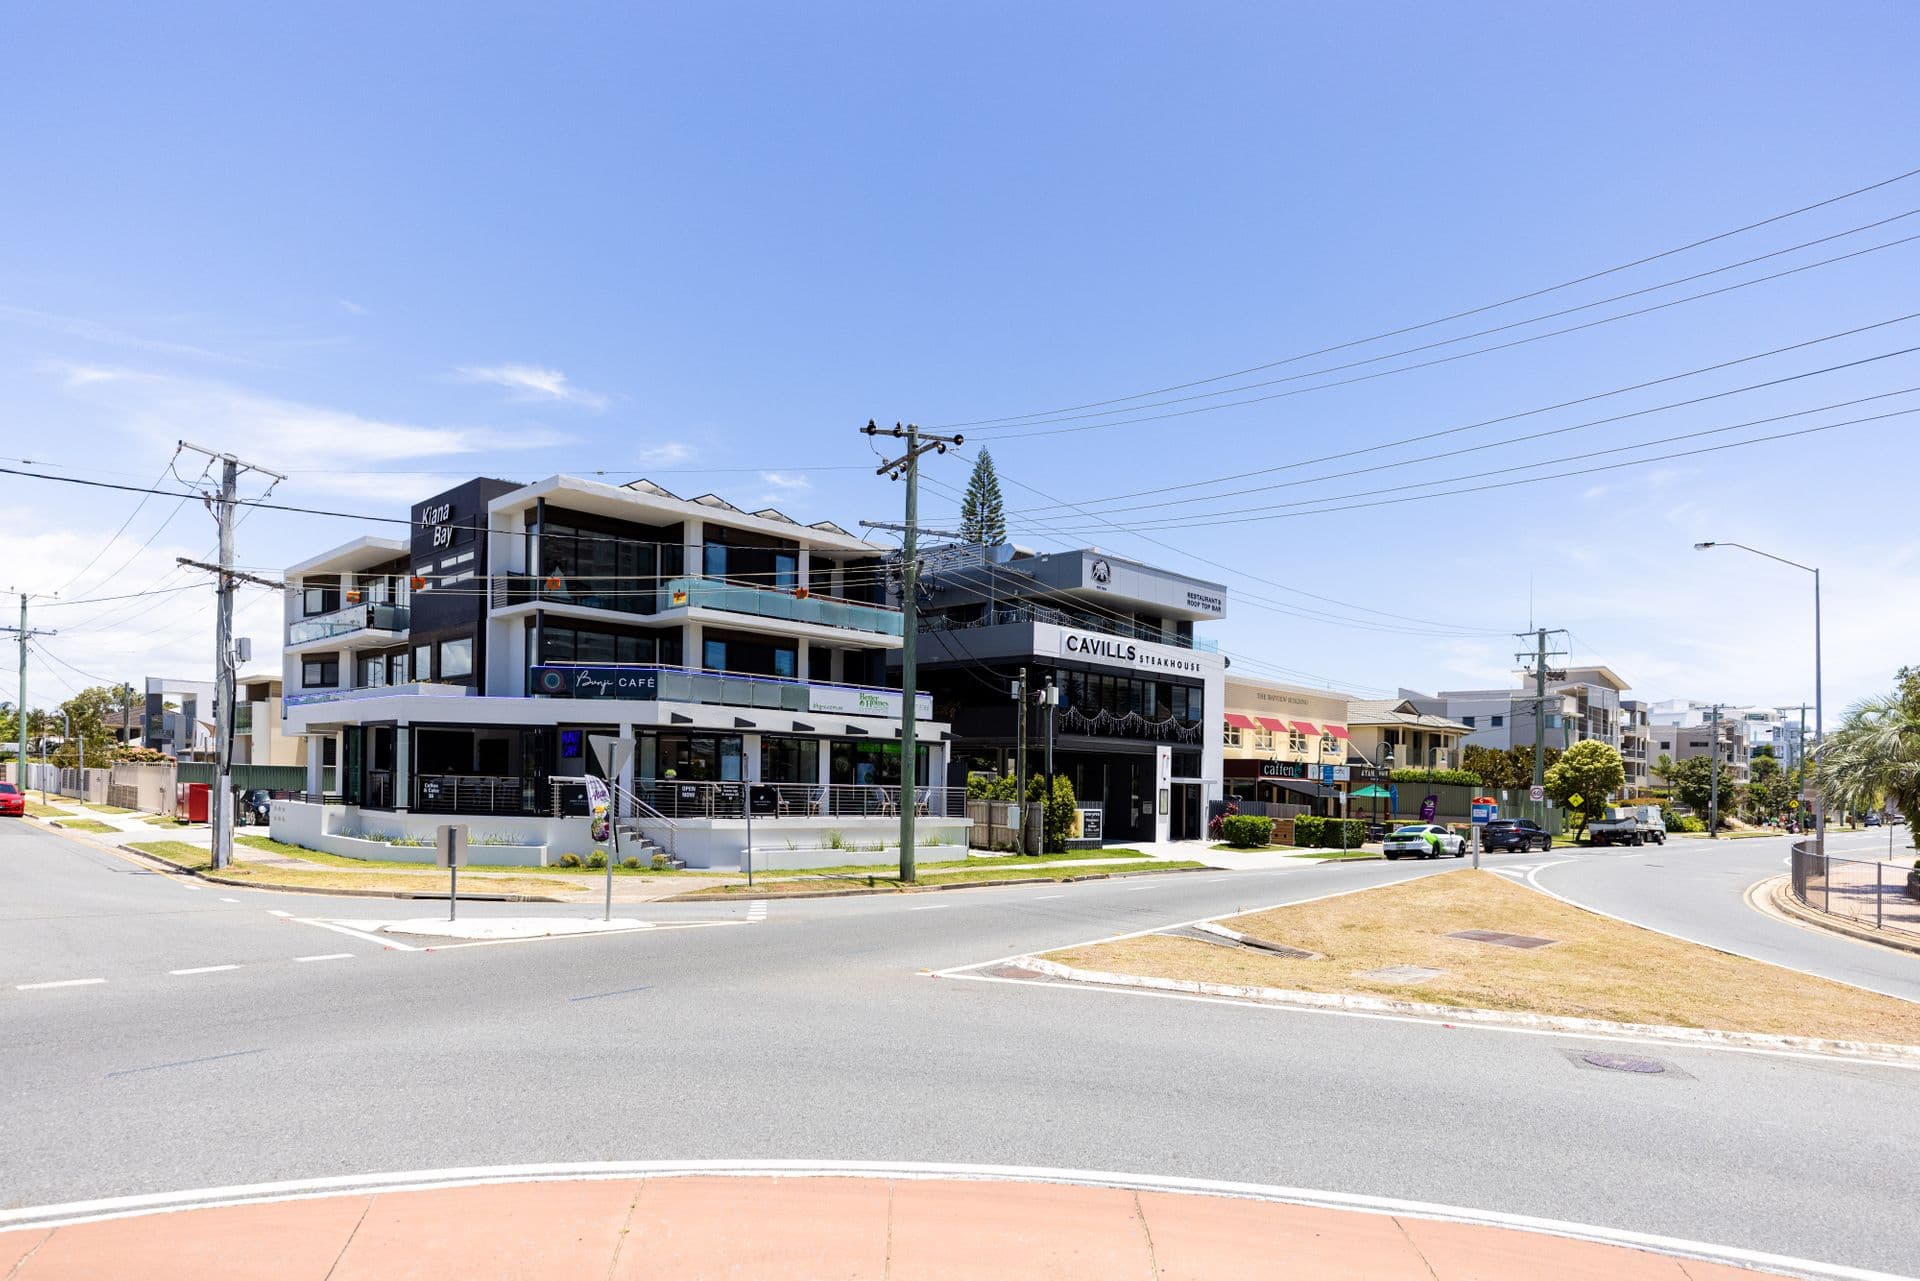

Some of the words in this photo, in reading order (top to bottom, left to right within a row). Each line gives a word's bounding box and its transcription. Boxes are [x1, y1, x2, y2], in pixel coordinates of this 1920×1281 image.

[421, 503, 450, 529] Kiana
[433, 525, 453, 548] Bay
[1187, 599, 1200, 608] ROOF
[1211, 604, 1222, 613] BAR
[1066, 635, 1136, 661] CAVILLS
[1139, 654, 1201, 672] STEAKHOUSE
[618, 677, 655, 688] CAFÉ
